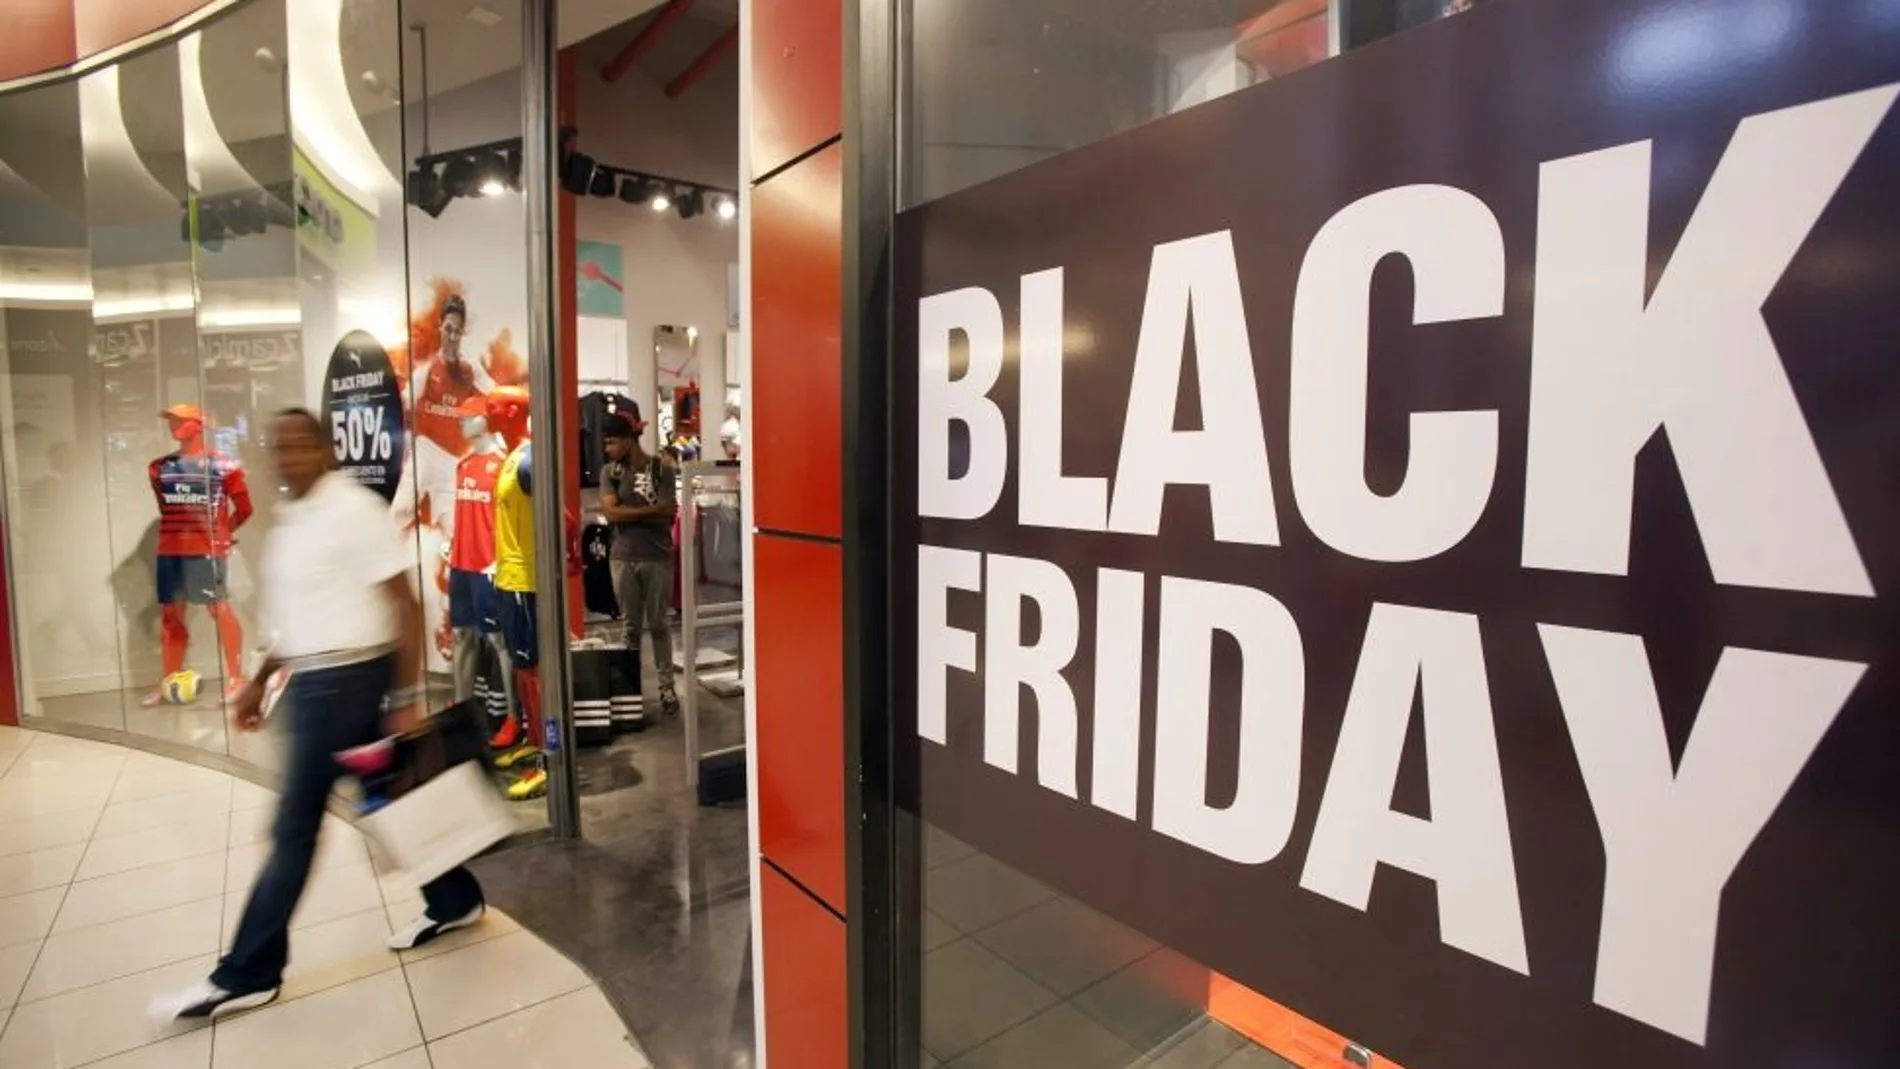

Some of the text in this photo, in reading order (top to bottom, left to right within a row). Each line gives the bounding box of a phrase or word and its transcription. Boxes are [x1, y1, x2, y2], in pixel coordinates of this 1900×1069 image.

[331, 370, 385, 393] BLACK FRIDAY
[331, 405, 392, 461] 50%
[918, 82, 1900, 597] BLACK
[918, 544, 1869, 1046] FRIDAY
